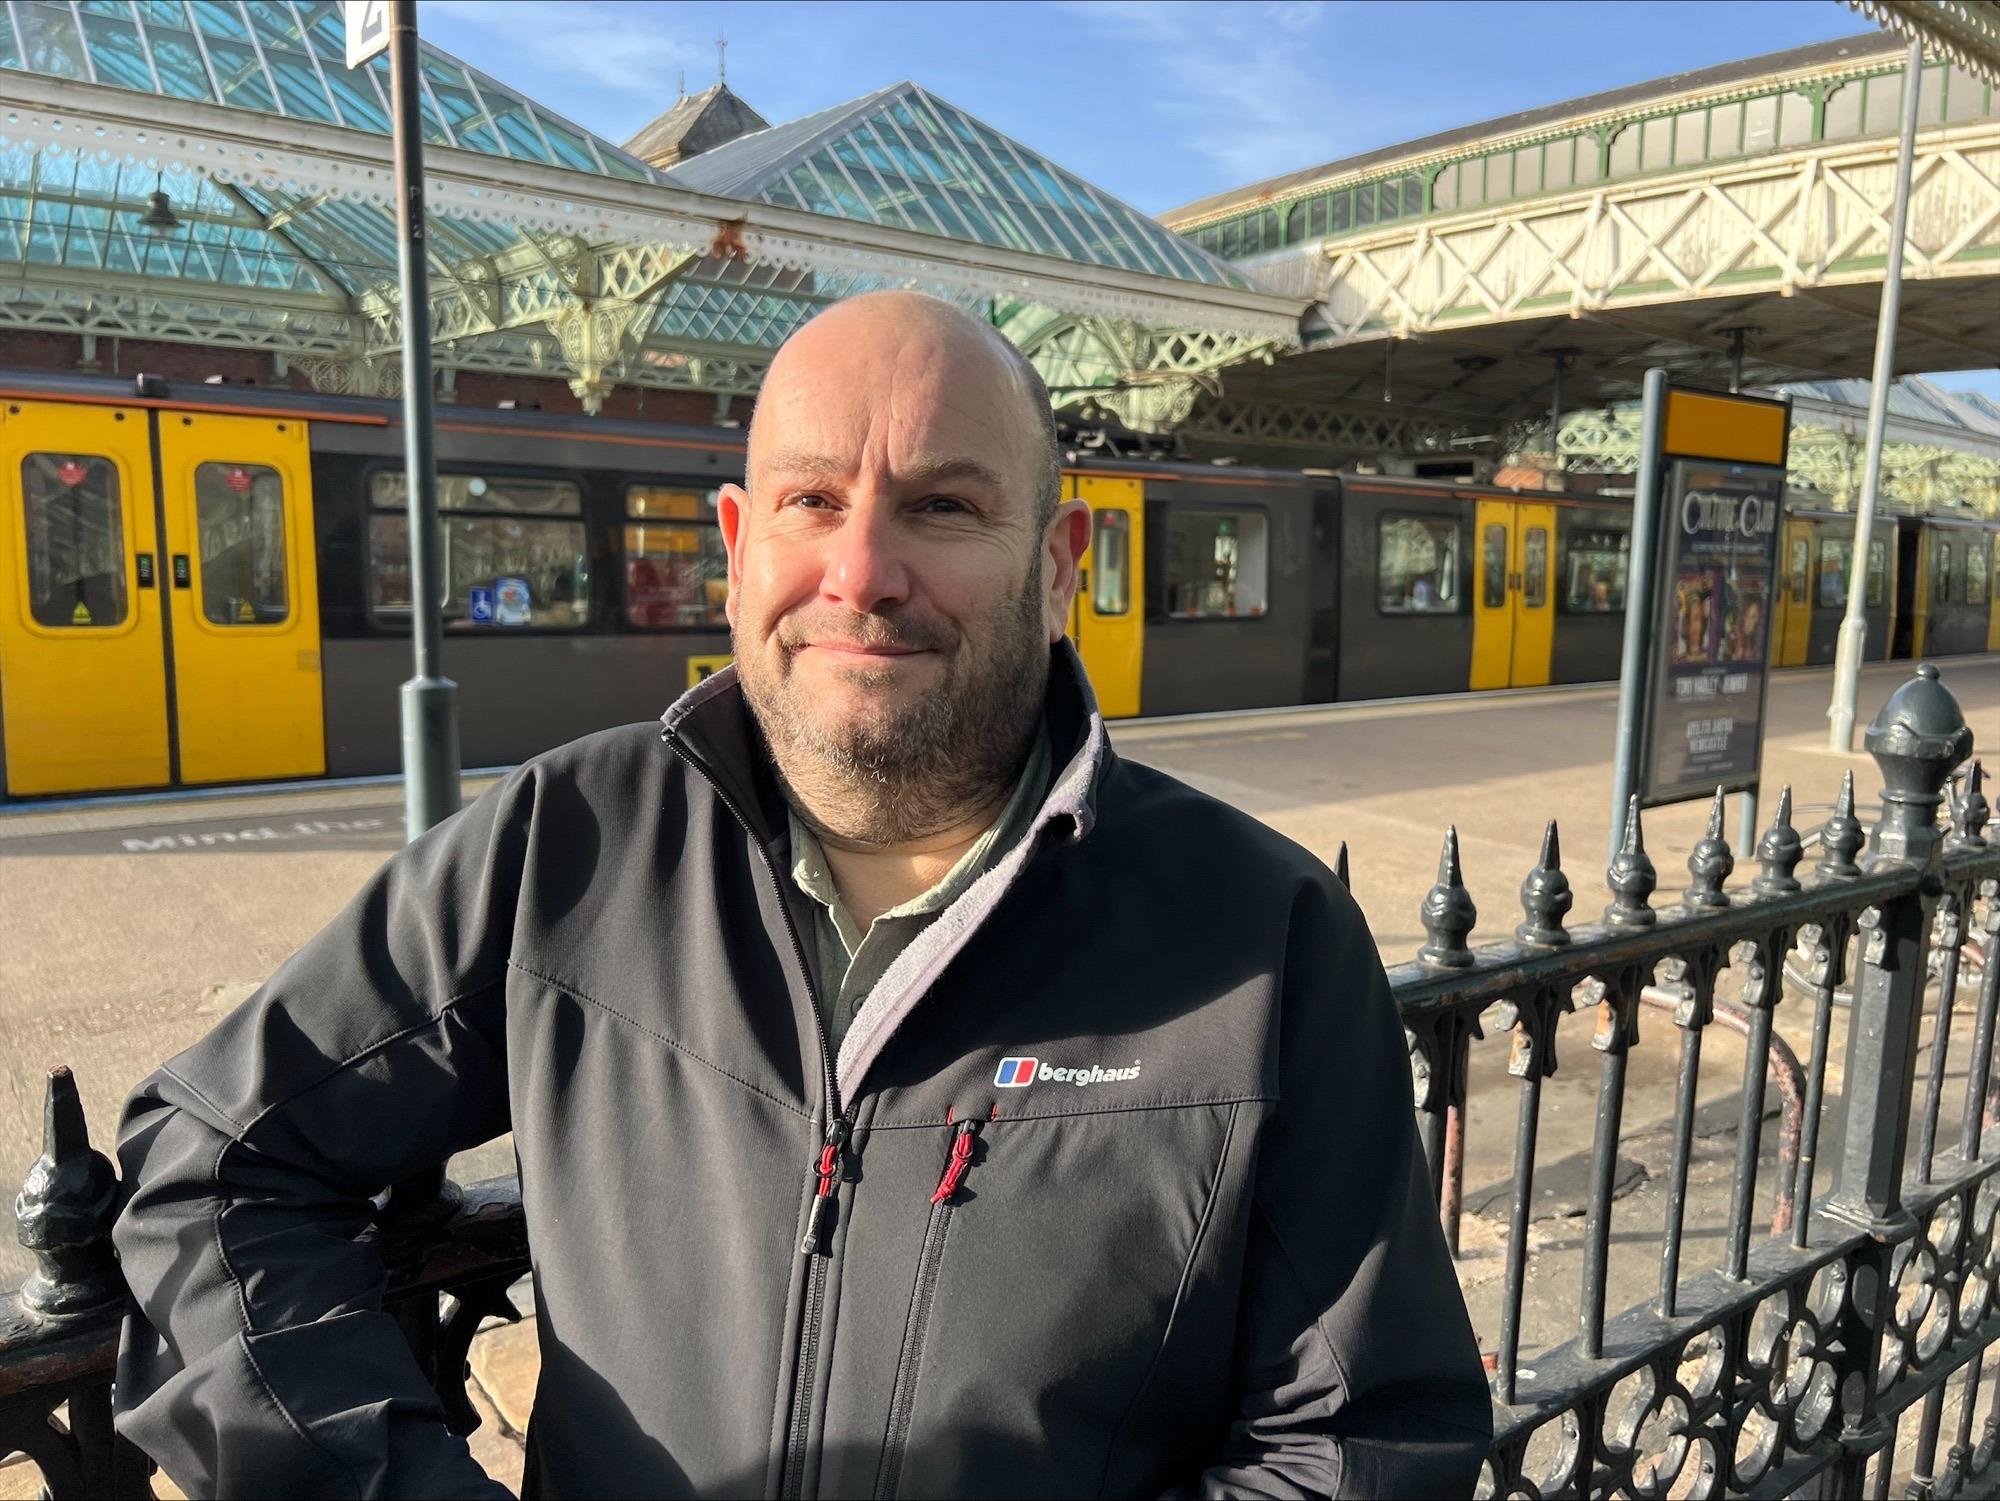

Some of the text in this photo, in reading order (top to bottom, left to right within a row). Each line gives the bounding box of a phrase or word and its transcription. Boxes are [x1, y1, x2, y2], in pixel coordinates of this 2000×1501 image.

[121, 826, 278, 851] Mind
[293, 818, 384, 835] the
[1038, 1063, 1140, 1086] berghaus
